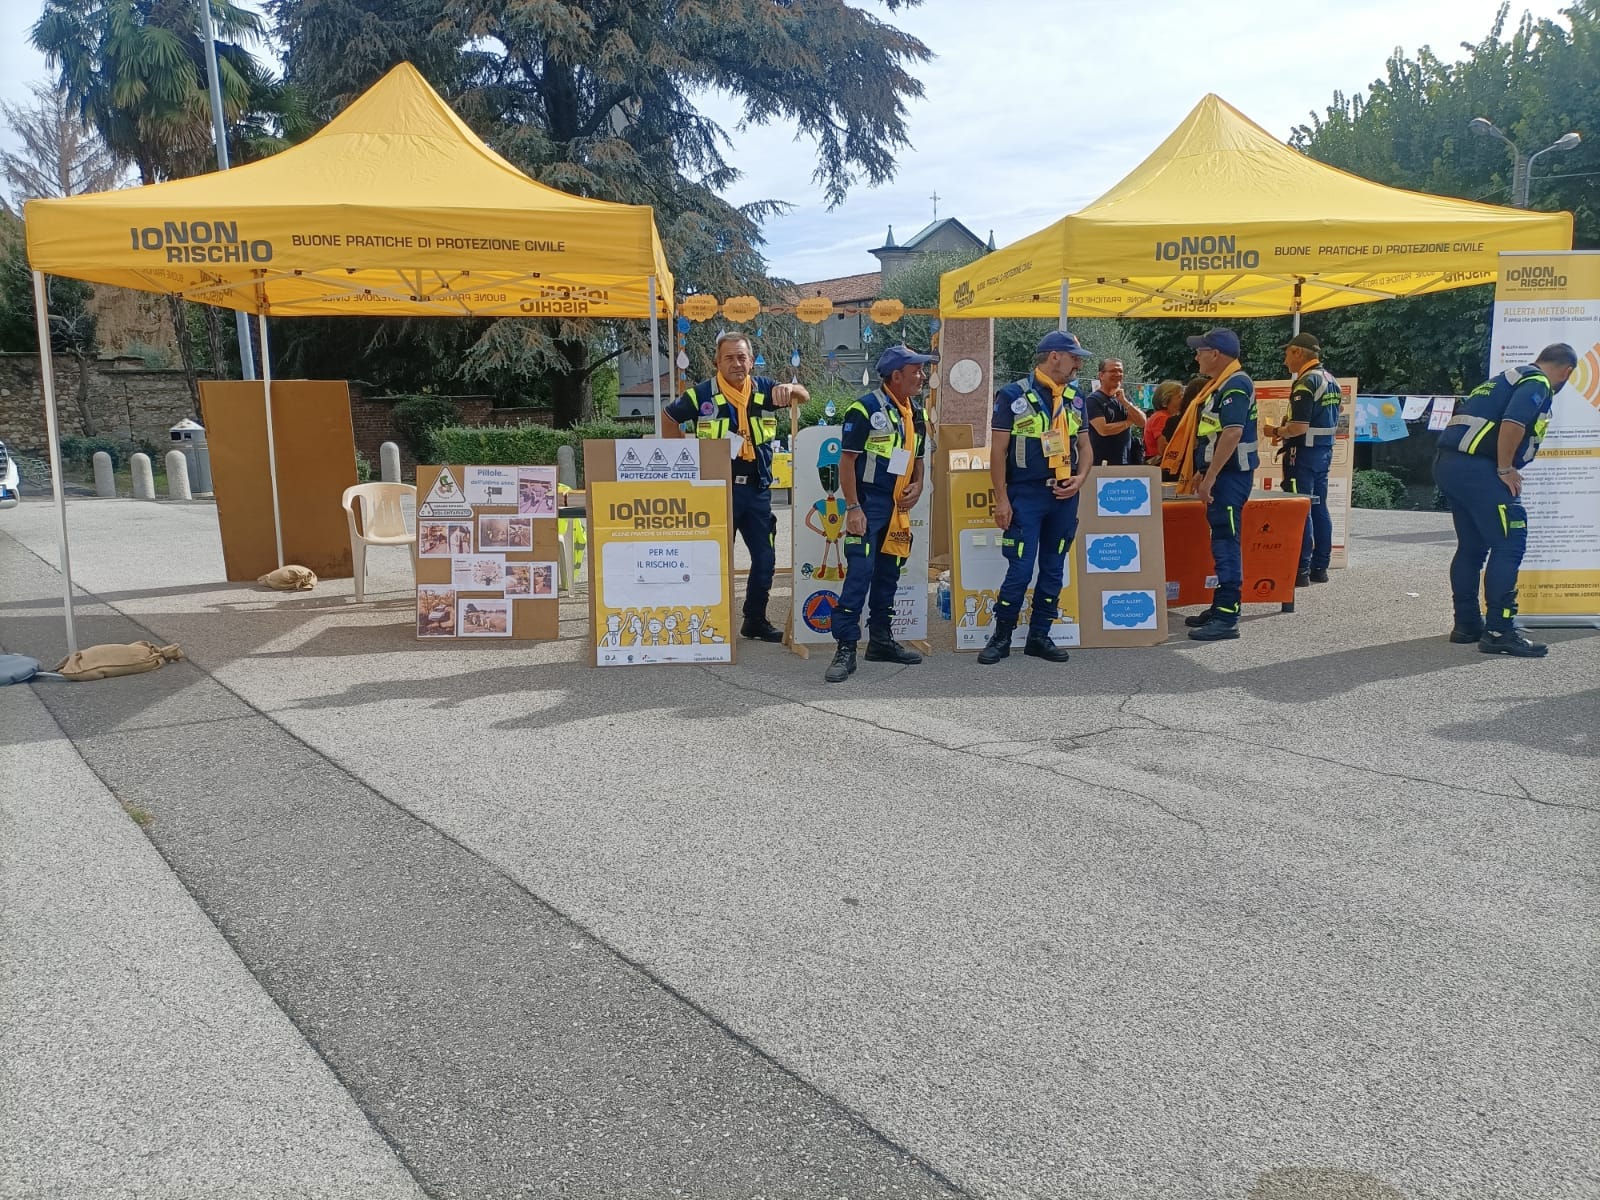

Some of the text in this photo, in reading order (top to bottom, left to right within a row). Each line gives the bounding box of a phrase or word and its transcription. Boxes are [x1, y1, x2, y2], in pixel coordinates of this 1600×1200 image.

[291, 234, 566, 253] BUONE PRATICHE DI PROTEZIONE CIVILE
[1274, 242, 1485, 256] BUONE PRATICHE DI PROTEZIONE CIVILE
[166, 239, 273, 264] RISCHIO
[1180, 249, 1260, 272] RISCHIO
[1520, 275, 1568, 288] RISCHIO
[1503, 306, 1586, 317] ALLERTA METEO-IDRO
[620, 472, 697, 480] PROTEZIONE CIVILE
[633, 511, 711, 530] RISCHIO
[648, 548, 680, 557] PER ME
[636, 561, 643, 569] IL
[645, 560, 678, 569] RISCHIO
[894, 599, 916, 607] UTTI
[890, 618, 919, 626] ZIONE
